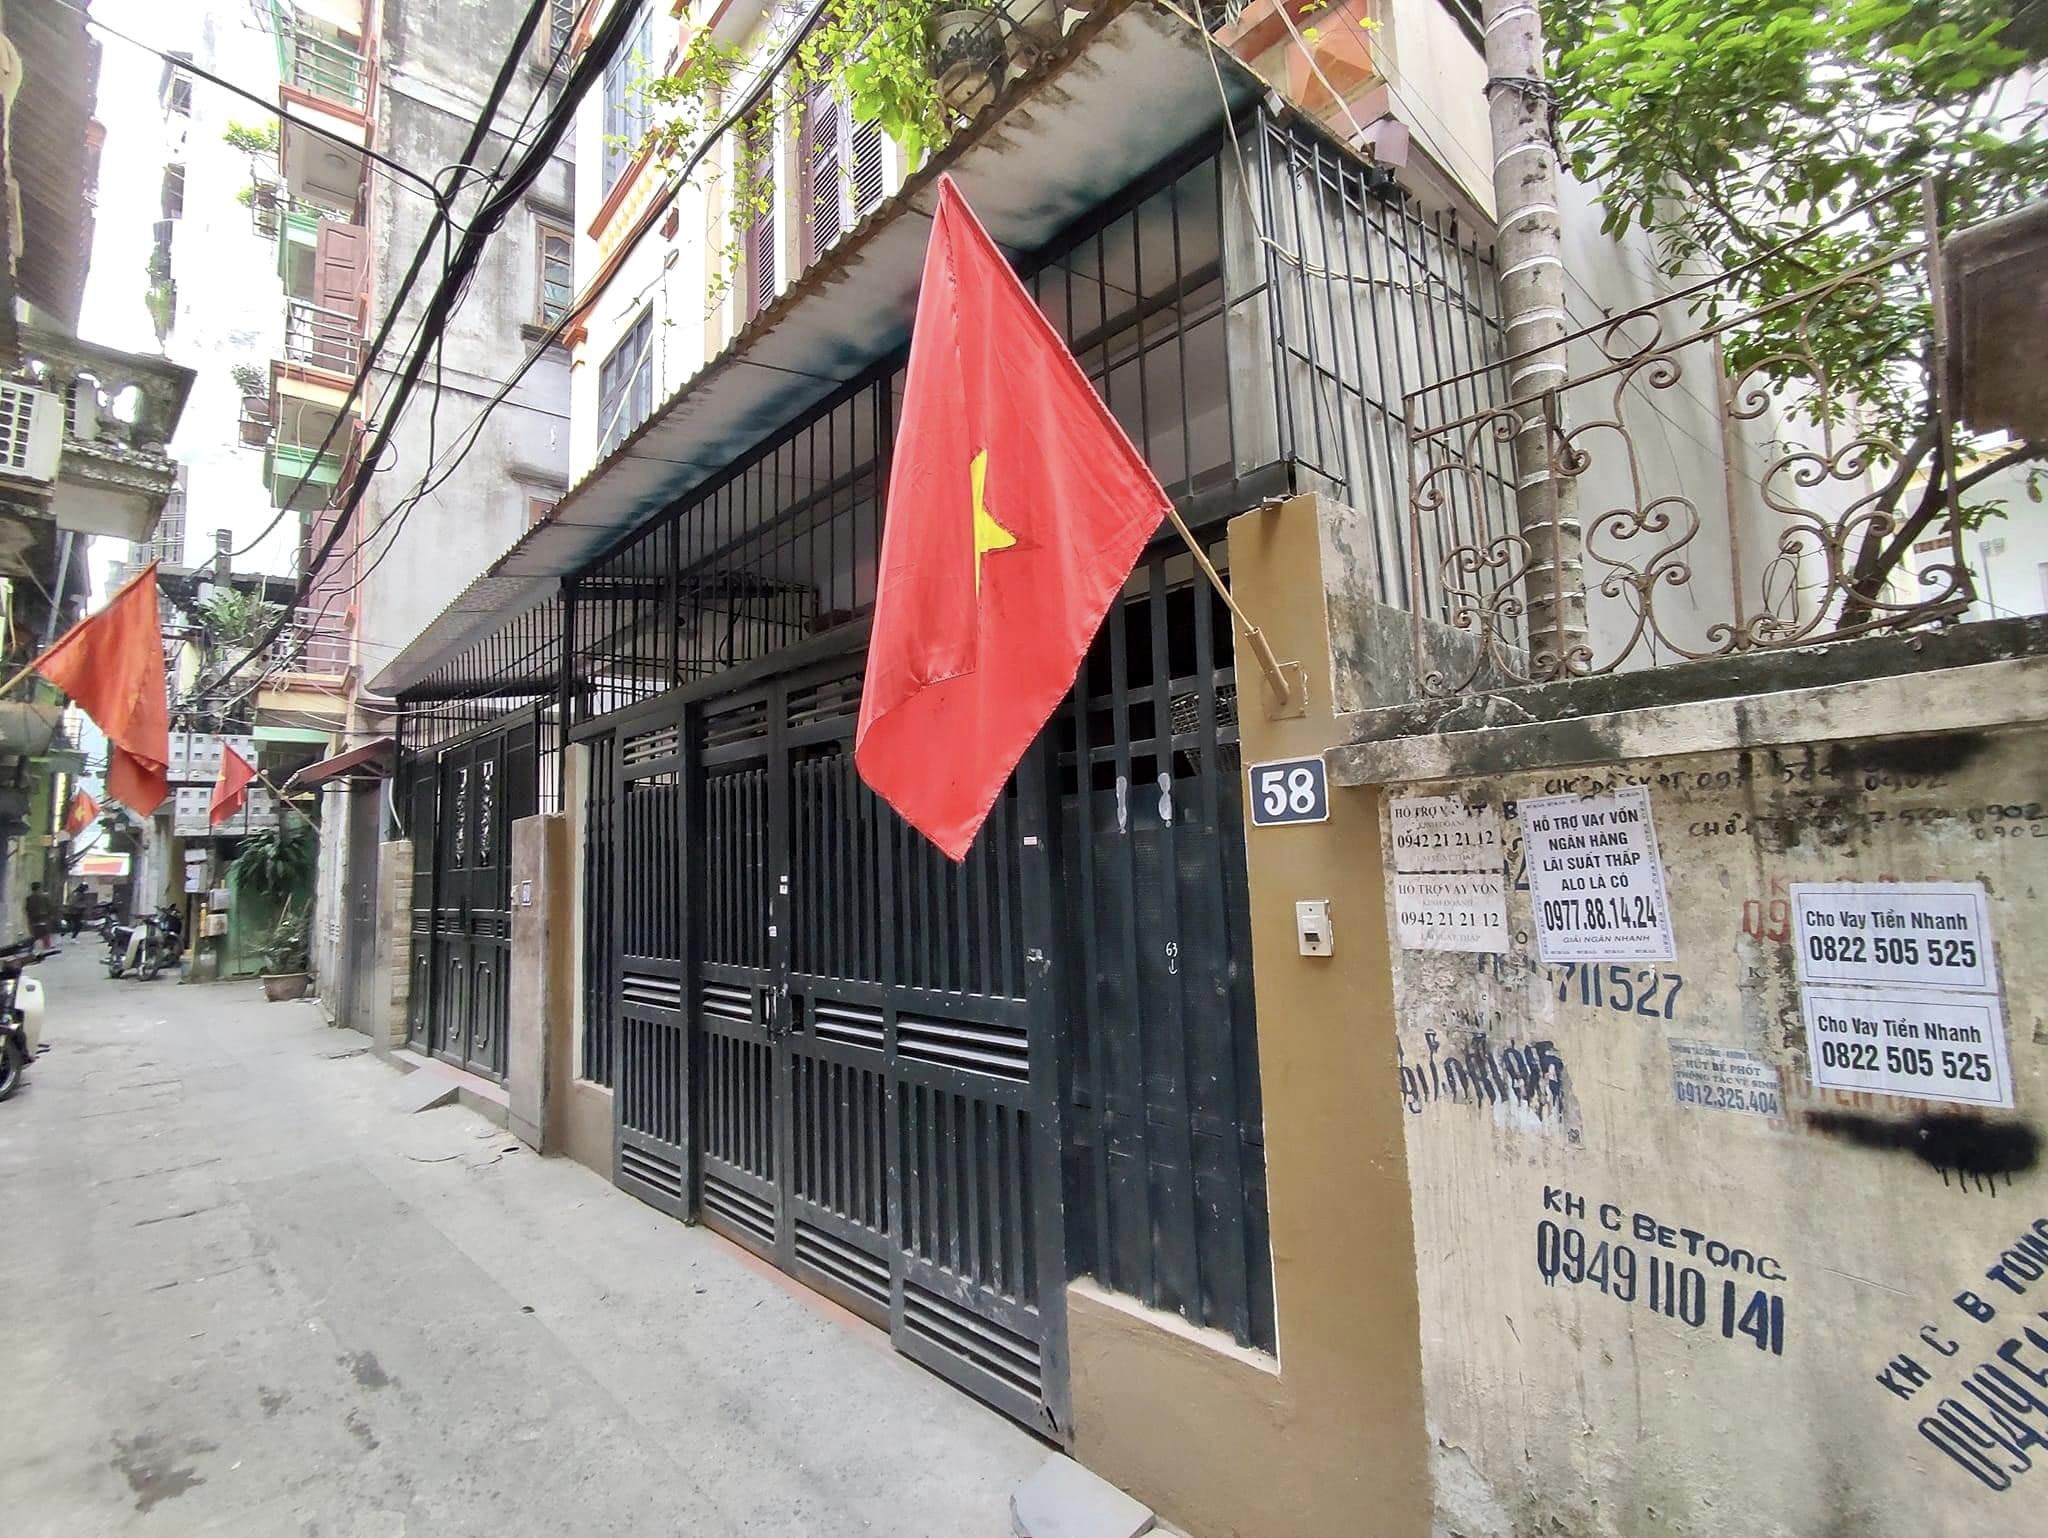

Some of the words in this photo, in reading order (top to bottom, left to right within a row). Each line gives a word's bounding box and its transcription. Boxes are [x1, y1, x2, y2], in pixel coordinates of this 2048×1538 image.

[1260, 767, 1316, 816] 58
[1553, 813, 1579, 833] TRỢ
[1582, 813, 1606, 828] VAY
[1609, 806, 1640, 825] VỐN
[1397, 833, 1430, 849] 0942
[1433, 832, 1449, 848] 21
[1455, 831, 1471, 847] 21
[1478, 829, 1495, 845] 12
[1548, 836, 1586, 851] NGÂN
[1589, 831, 1629, 848] HÀNG
[1542, 857, 1564, 872] LÃI
[1567, 852, 1601, 870] SUẤT
[1604, 849, 1641, 867] THẤP
[1561, 877, 1586, 891] ALO
[1590, 874, 1606, 889] LÀ
[1610, 872, 1629, 888] CÓ
[1401, 911, 1433, 926] 0942
[1438, 911, 1454, 926] 21
[1460, 911, 1476, 926] 21
[1483, 911, 1500, 927] 12
[1543, 894, 1657, 932] 0977.88.14.24
[1806, 910, 1835, 928] Cho
[1839, 911, 1866, 930] Vay
[1910, 911, 1968, 931] Nhanh
[1809, 935, 1868, 963] 0822
[1873, 937, 1919, 965] 505
[1927, 938, 1977, 968] 525
[1817, 1015, 1847, 1034] Cho
[1851, 1017, 1879, 1038] Vay
[1925, 1022, 1982, 1043] Nhanh
[1822, 1041, 1880, 1072] 0822
[1886, 1045, 1934, 1077] 505
[1942, 1051, 1992, 1082] 525
[1676, 1081, 1779, 1114] 0912.325.404
[1543, 1184, 1585, 1219] KH
[1536, 1219, 1637, 1302] 0949
[1650, 1255, 1706, 1328] 110
[1721, 1280, 1785, 1356] 141
[1876, 1353, 1932, 1401] KH
[1952, 1290, 1996, 1324] B
